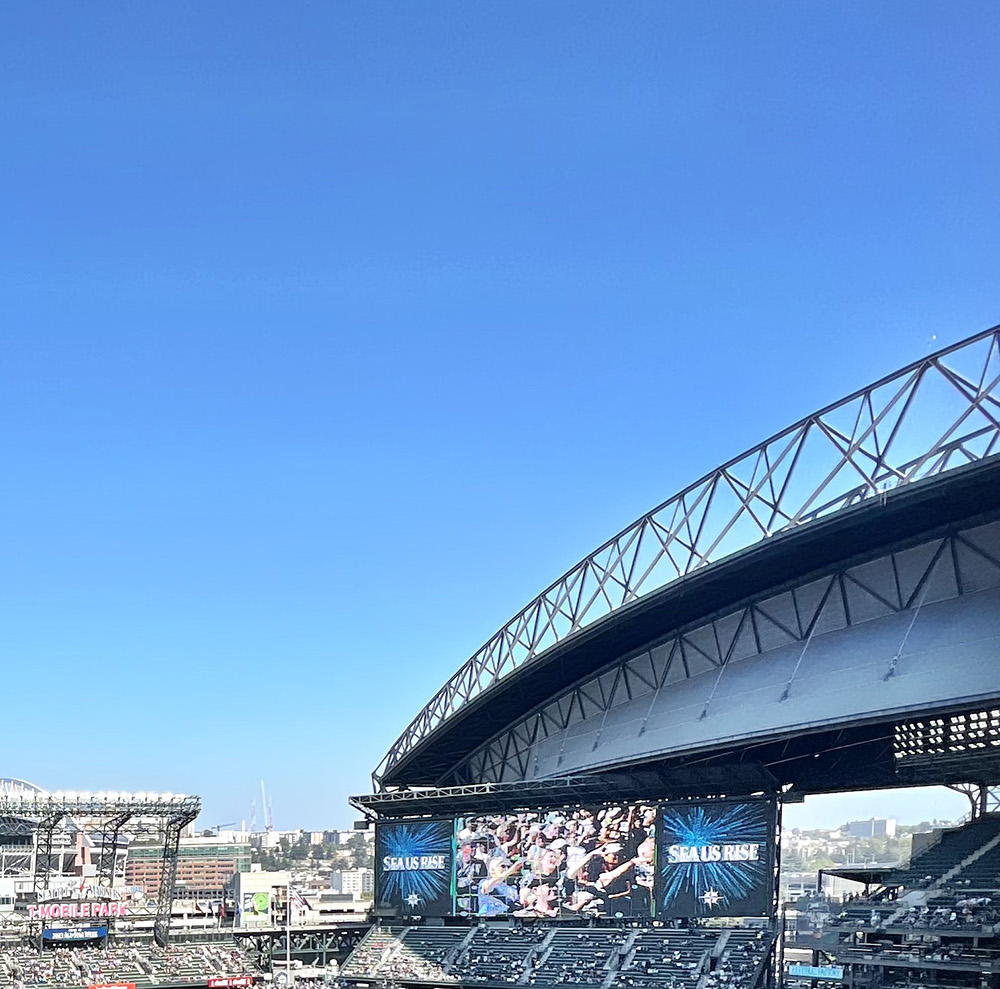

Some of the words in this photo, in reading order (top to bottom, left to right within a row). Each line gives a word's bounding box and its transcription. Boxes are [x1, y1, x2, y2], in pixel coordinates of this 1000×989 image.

[667, 844, 700, 863] SEA
[700, 845, 721, 861] US
[721, 844, 759, 861] RISE
[383, 856, 405, 871] SEA
[405, 856, 419, 870] US
[420, 855, 445, 869] RISE
[27, 903, 90, 919] T-MOBILE
[92, 902, 128, 917] PARK
